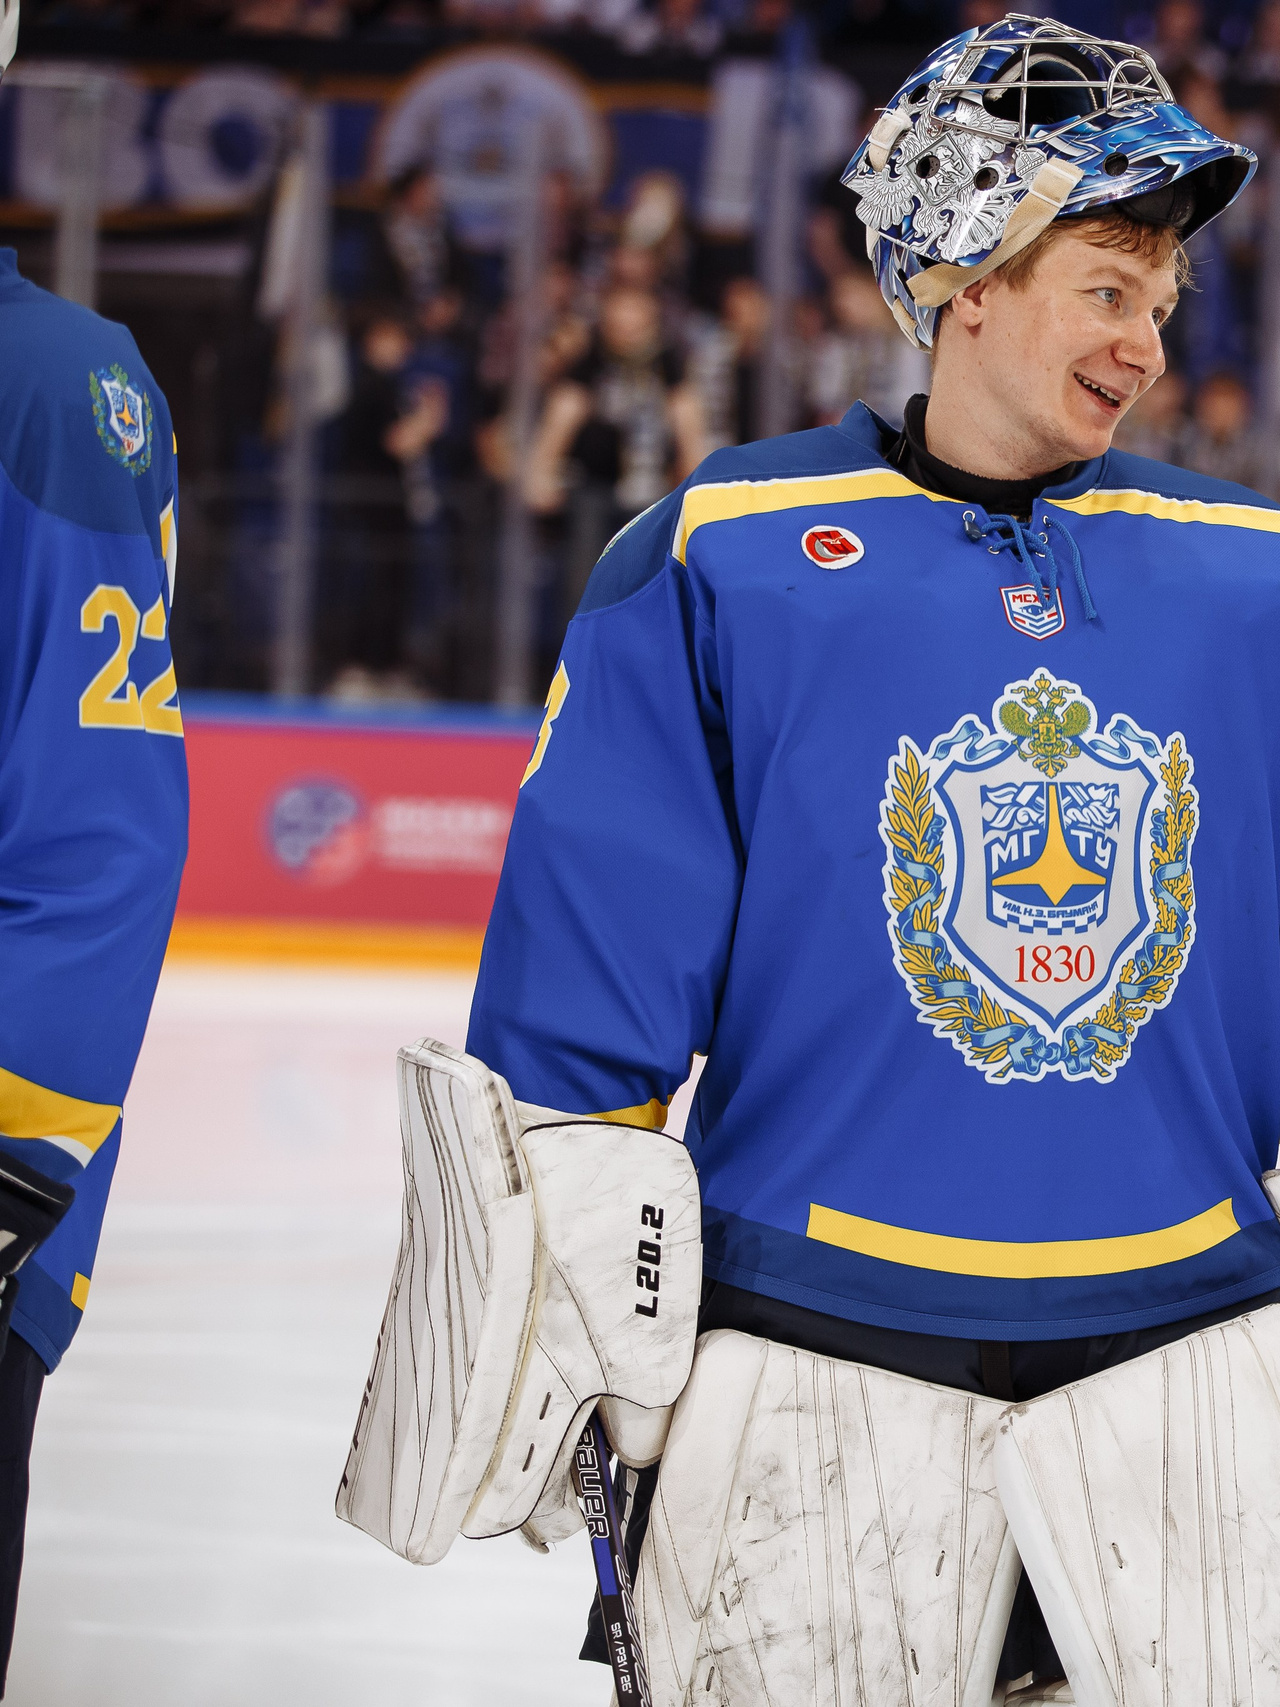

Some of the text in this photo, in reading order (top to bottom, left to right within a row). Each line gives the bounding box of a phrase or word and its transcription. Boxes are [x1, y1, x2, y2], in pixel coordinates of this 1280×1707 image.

[1047, 901, 1098, 918] БАУМАНА
[1015, 945, 1095, 983] 1830
[635, 1203, 664, 1318] L20.2
[611, 1622, 622, 1639] SR
[615, 1646, 628, 1667] P31
